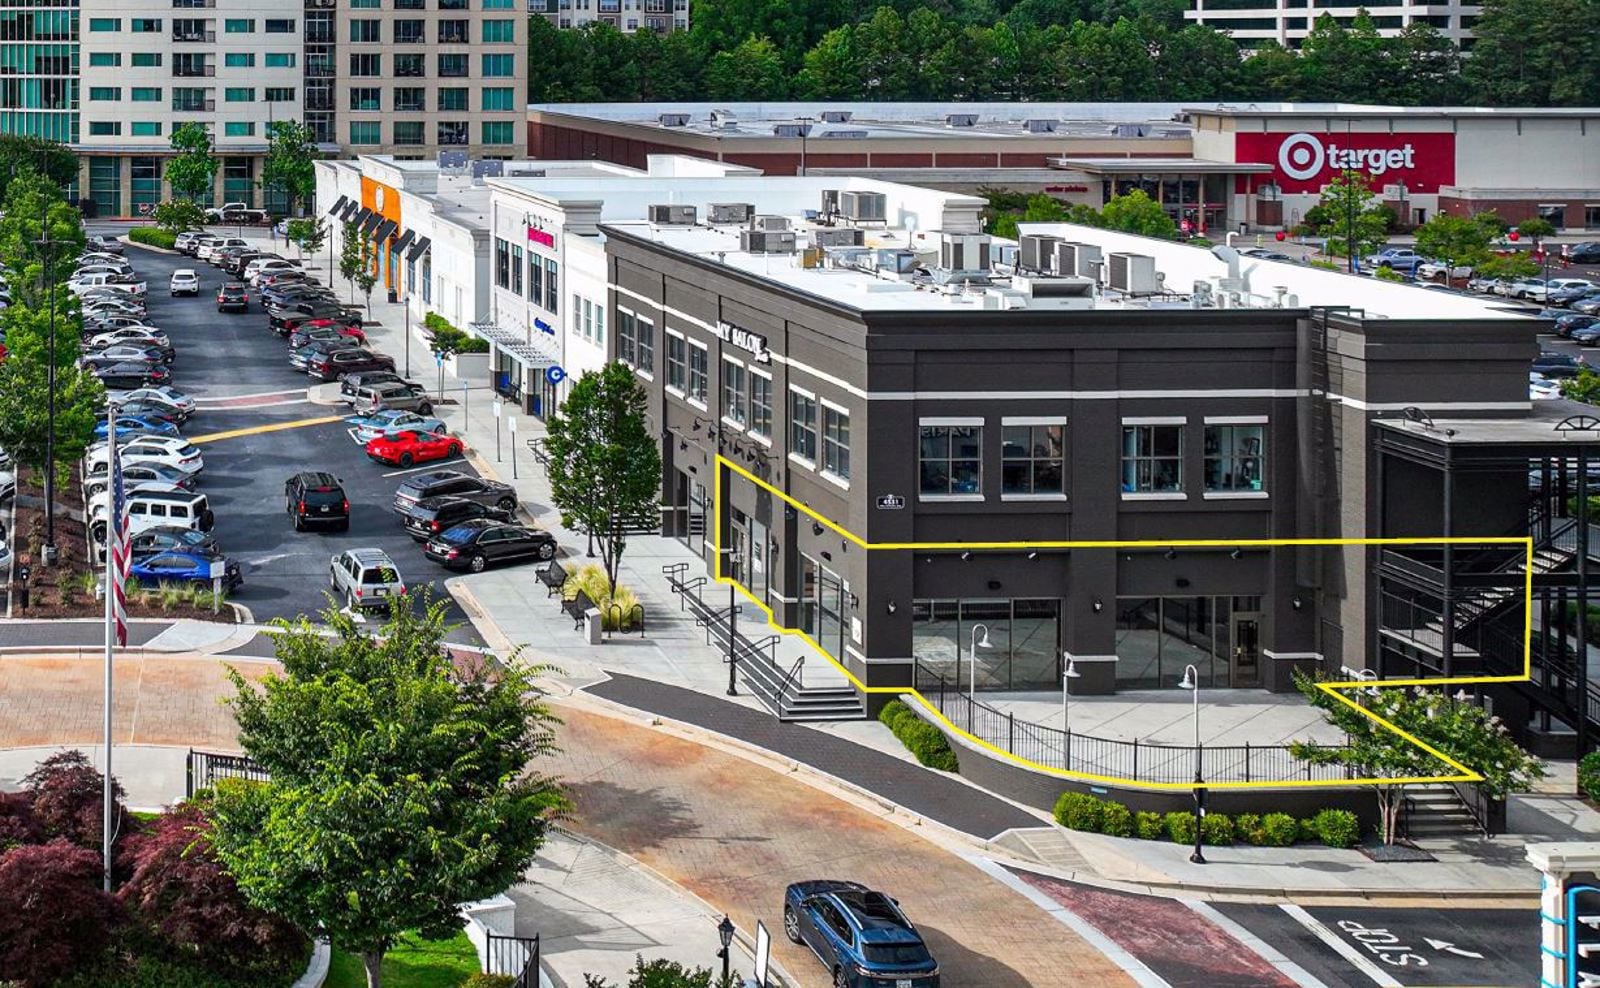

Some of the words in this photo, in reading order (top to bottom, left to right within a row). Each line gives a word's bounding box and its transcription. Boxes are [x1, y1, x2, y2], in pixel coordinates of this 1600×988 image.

[1327, 144, 1415, 175] target
[551, 369, 561, 380] C
[1337, 920, 1429, 967] STOP
